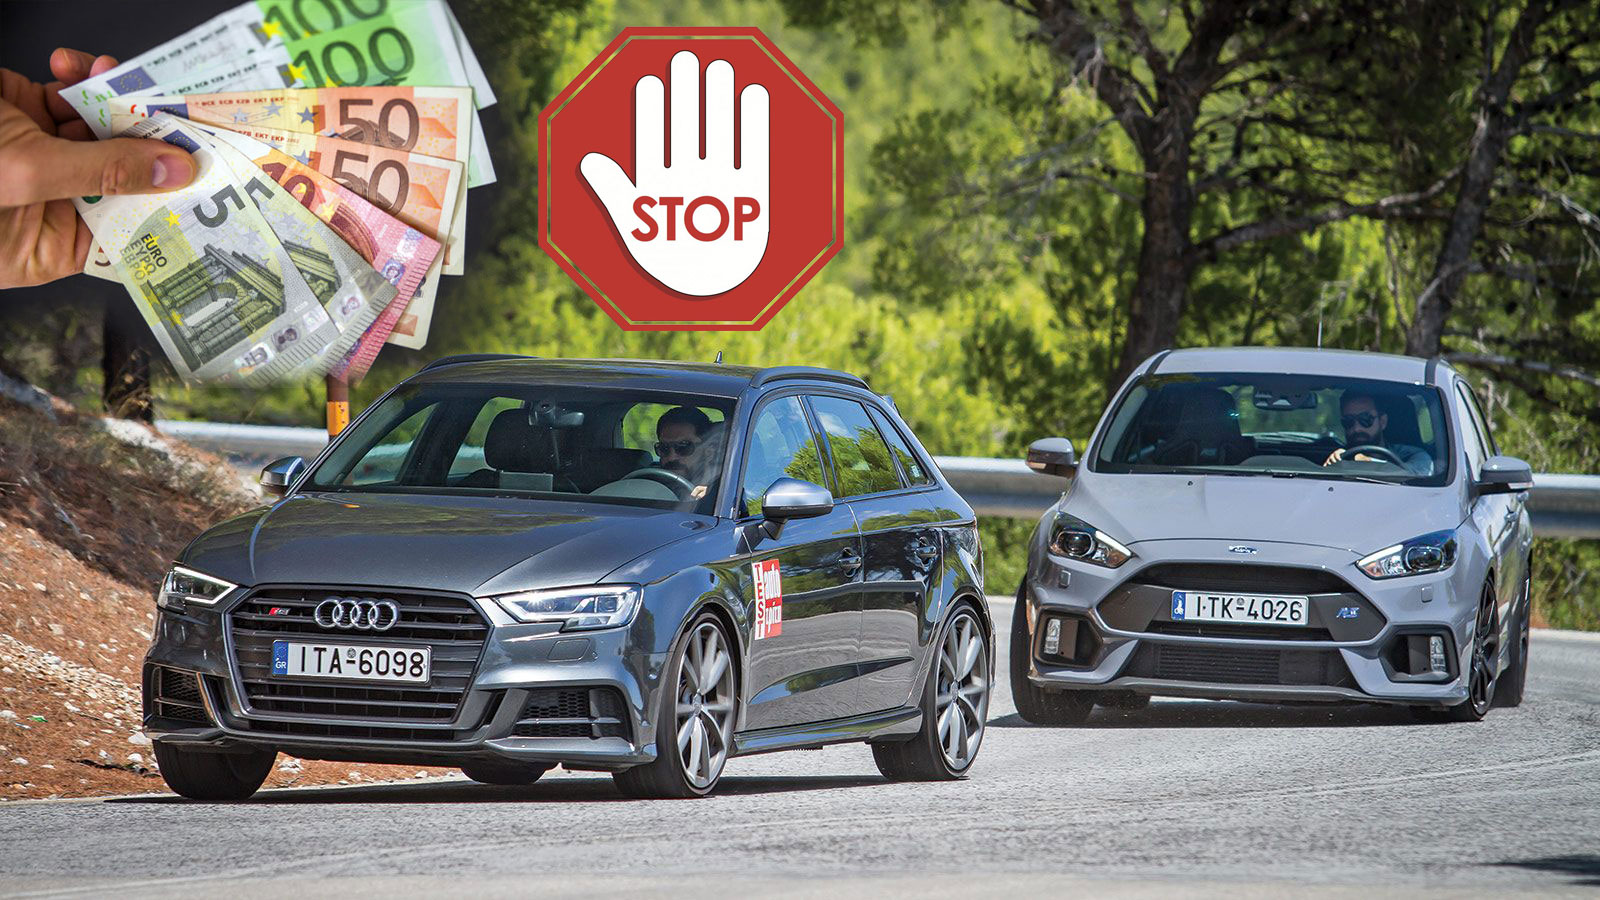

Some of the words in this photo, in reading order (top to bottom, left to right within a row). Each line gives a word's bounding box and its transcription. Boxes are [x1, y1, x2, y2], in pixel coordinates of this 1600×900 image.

[292, 27, 415, 87] 100
[339, 98, 420, 152] 50
[193, 184, 246, 229] 5
[332, 150, 410, 216] 50
[141, 232, 168, 268] EURO
[754, 564, 764, 638] TEST
[763, 563, 781, 600] auto
[275, 661, 287, 669] GR
